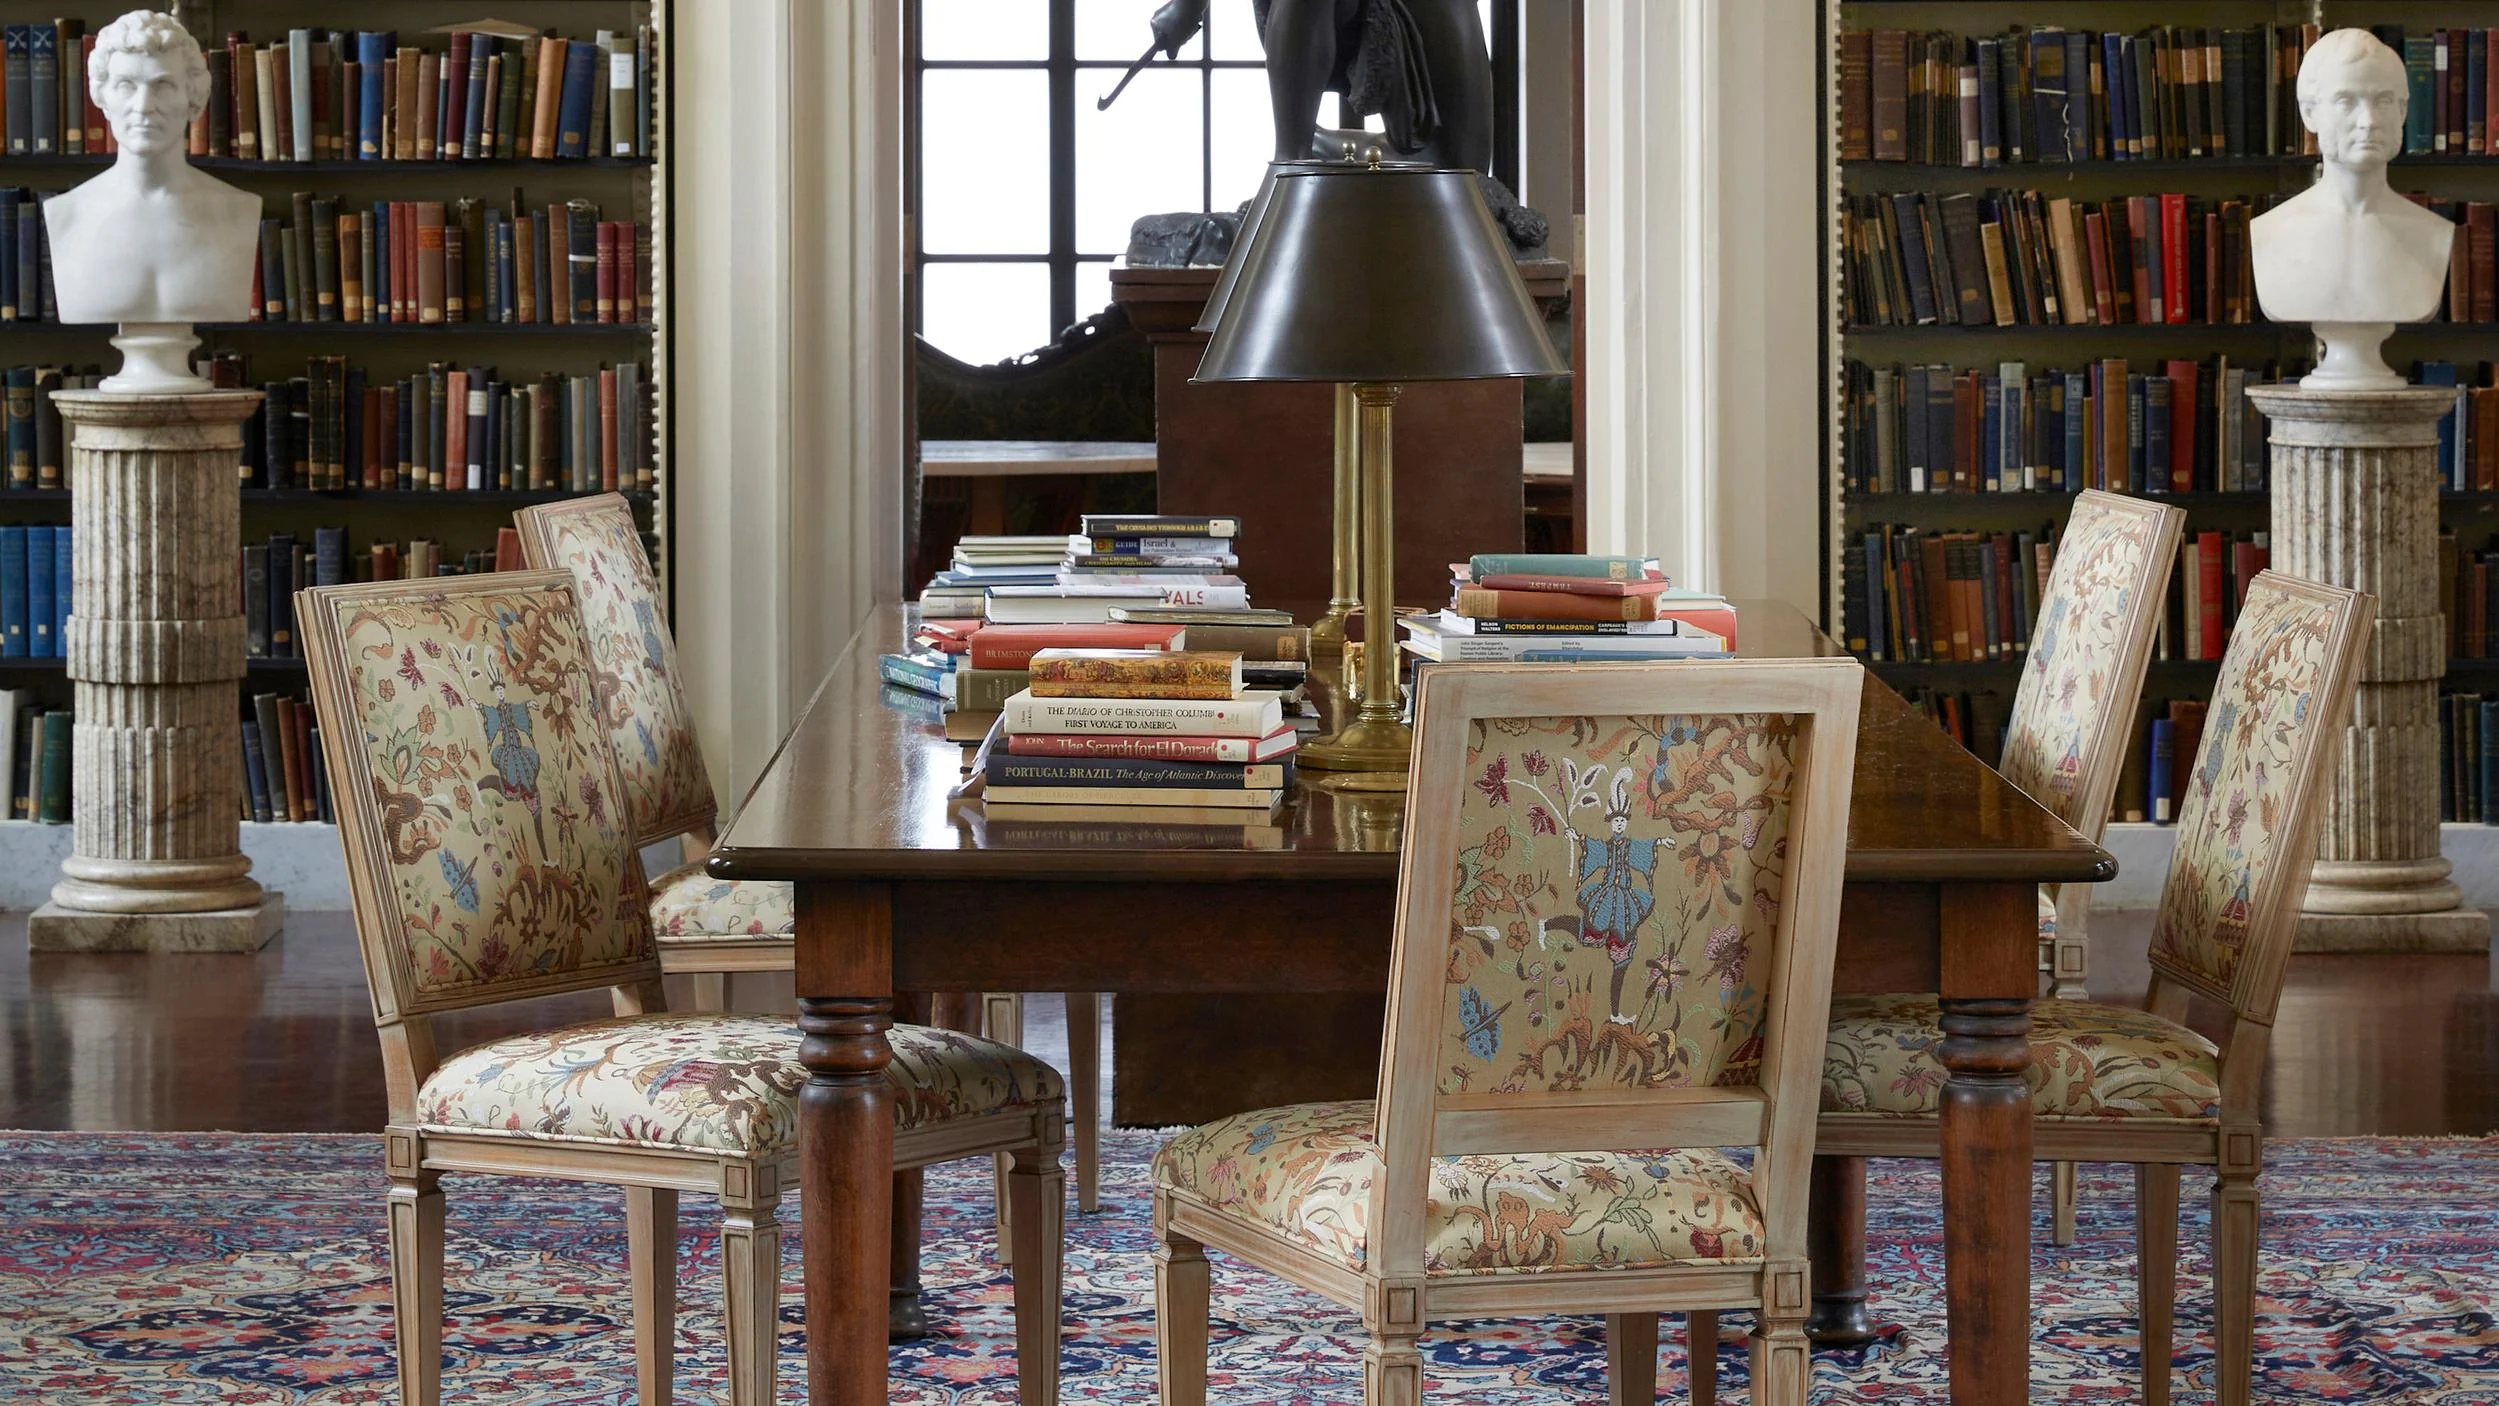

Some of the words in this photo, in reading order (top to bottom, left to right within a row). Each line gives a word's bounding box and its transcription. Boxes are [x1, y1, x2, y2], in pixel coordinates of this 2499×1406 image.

[1115, 540, 1138, 549] GUIDE
[1143, 538, 1168, 548] Israel
[1505, 623, 1536, 631] FICTIONS
[1537, 623, 1545, 631] OF
[1546, 623, 1595, 632] EMANCIPATION
[986, 649, 1038, 658] BRIMSTON
[1047, 706, 1065, 715] THE
[1067, 706, 1098, 716] DIARIO
[1100, 707, 1112, 716] OF
[1115, 707, 1173, 717] CHRISTOPHER
[1065, 720, 1088, 728] FIRST
[1090, 720, 1123, 729] VOYAGE
[1125, 720, 1138, 729] TO
[1138, 721, 1177, 730] AMERICA
[1025, 737, 1045, 745] JOHN
[1056, 738, 1084, 752] The
[1086, 739, 1133, 756] Search
[1134, 740, 1155, 757] for
[1156, 740, 1169, 757] El
[1171, 741, 1218, 757] Dorad
[1115, 768, 1135, 779] The
[1135, 769, 1154, 782] Age
[1154, 769, 1168, 783] of
[1168, 769, 1202, 781] Atlantic
